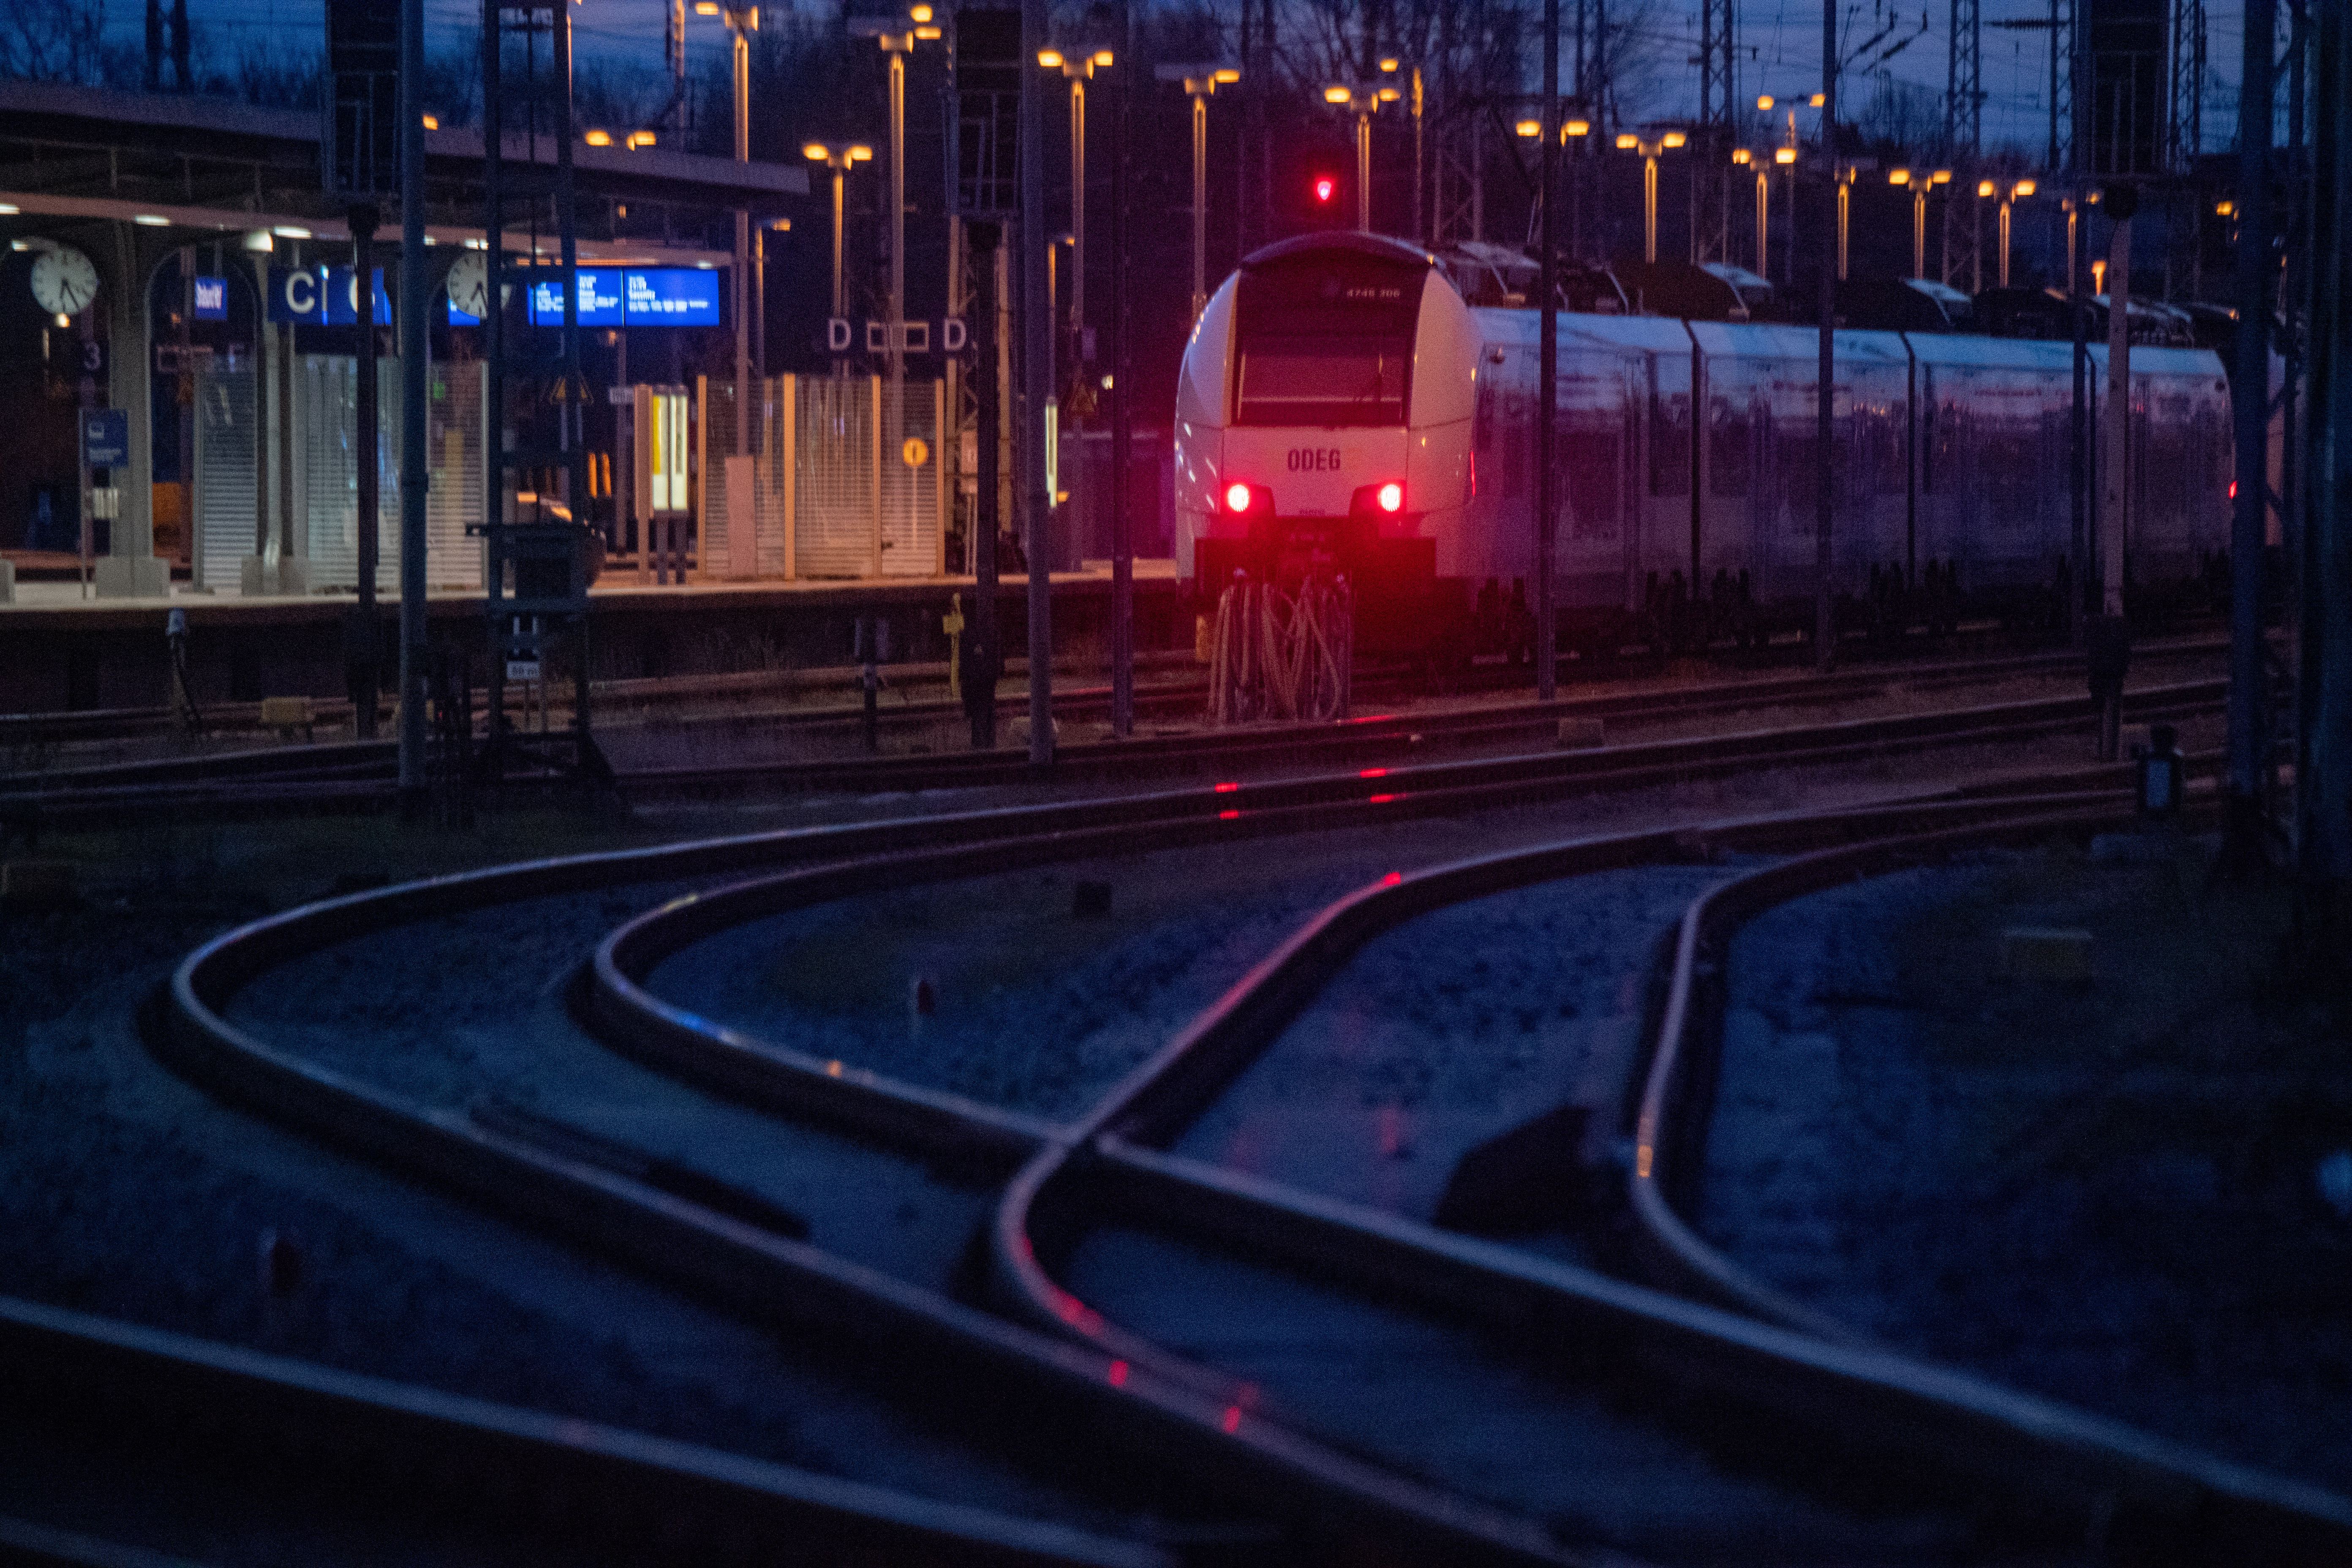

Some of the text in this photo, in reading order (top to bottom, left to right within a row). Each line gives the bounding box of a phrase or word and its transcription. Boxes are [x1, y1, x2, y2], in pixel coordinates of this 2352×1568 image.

[286, 271, 315, 314] C
[829, 318, 852, 350] D
[944, 318, 966, 350] D
[84, 341, 102, 371] 3
[1288, 448, 1340, 471] ODEG
